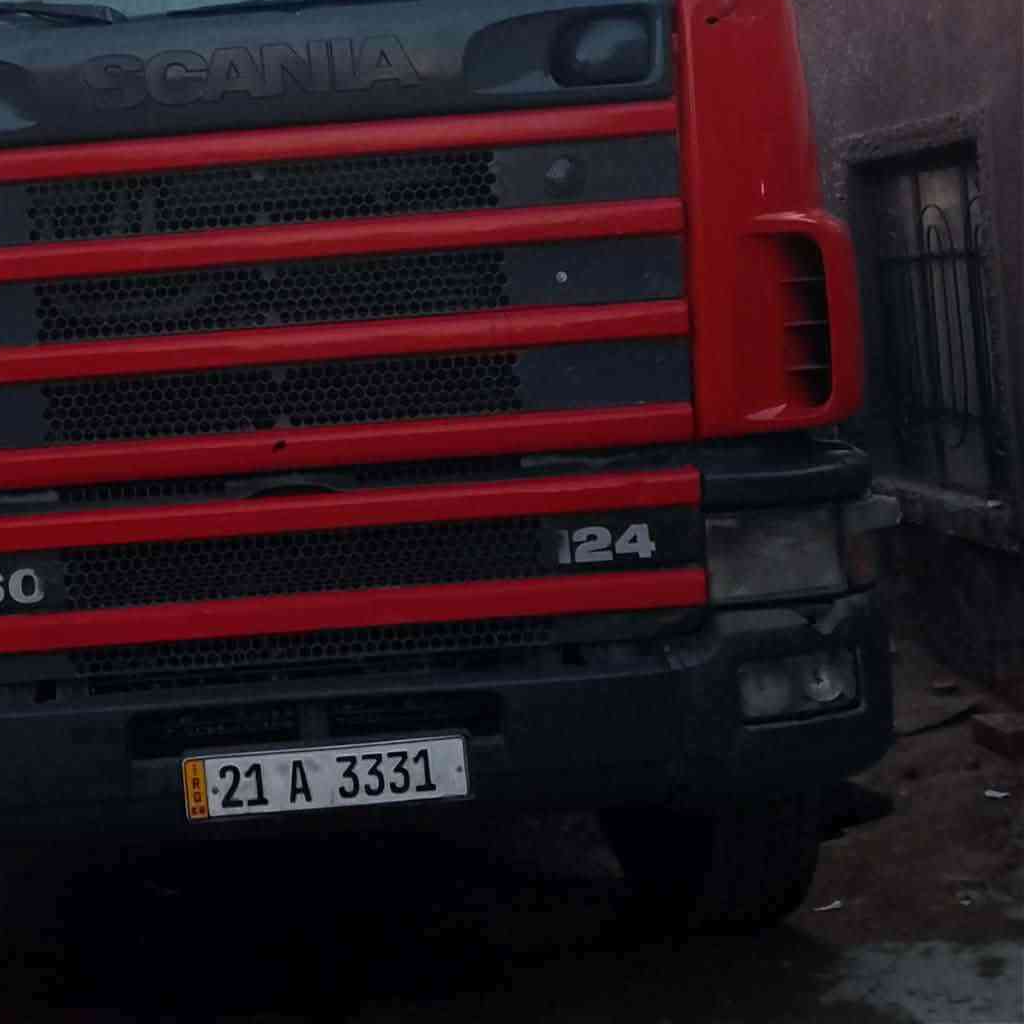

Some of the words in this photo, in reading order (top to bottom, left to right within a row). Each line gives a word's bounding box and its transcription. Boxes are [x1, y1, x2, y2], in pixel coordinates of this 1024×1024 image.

[80, 34, 422, 110] SCANIA
[558, 523, 656, 564] 124
[219, 763, 269, 808] 21
[289, 760, 313, 803] A
[336, 749, 437, 799] 3331
